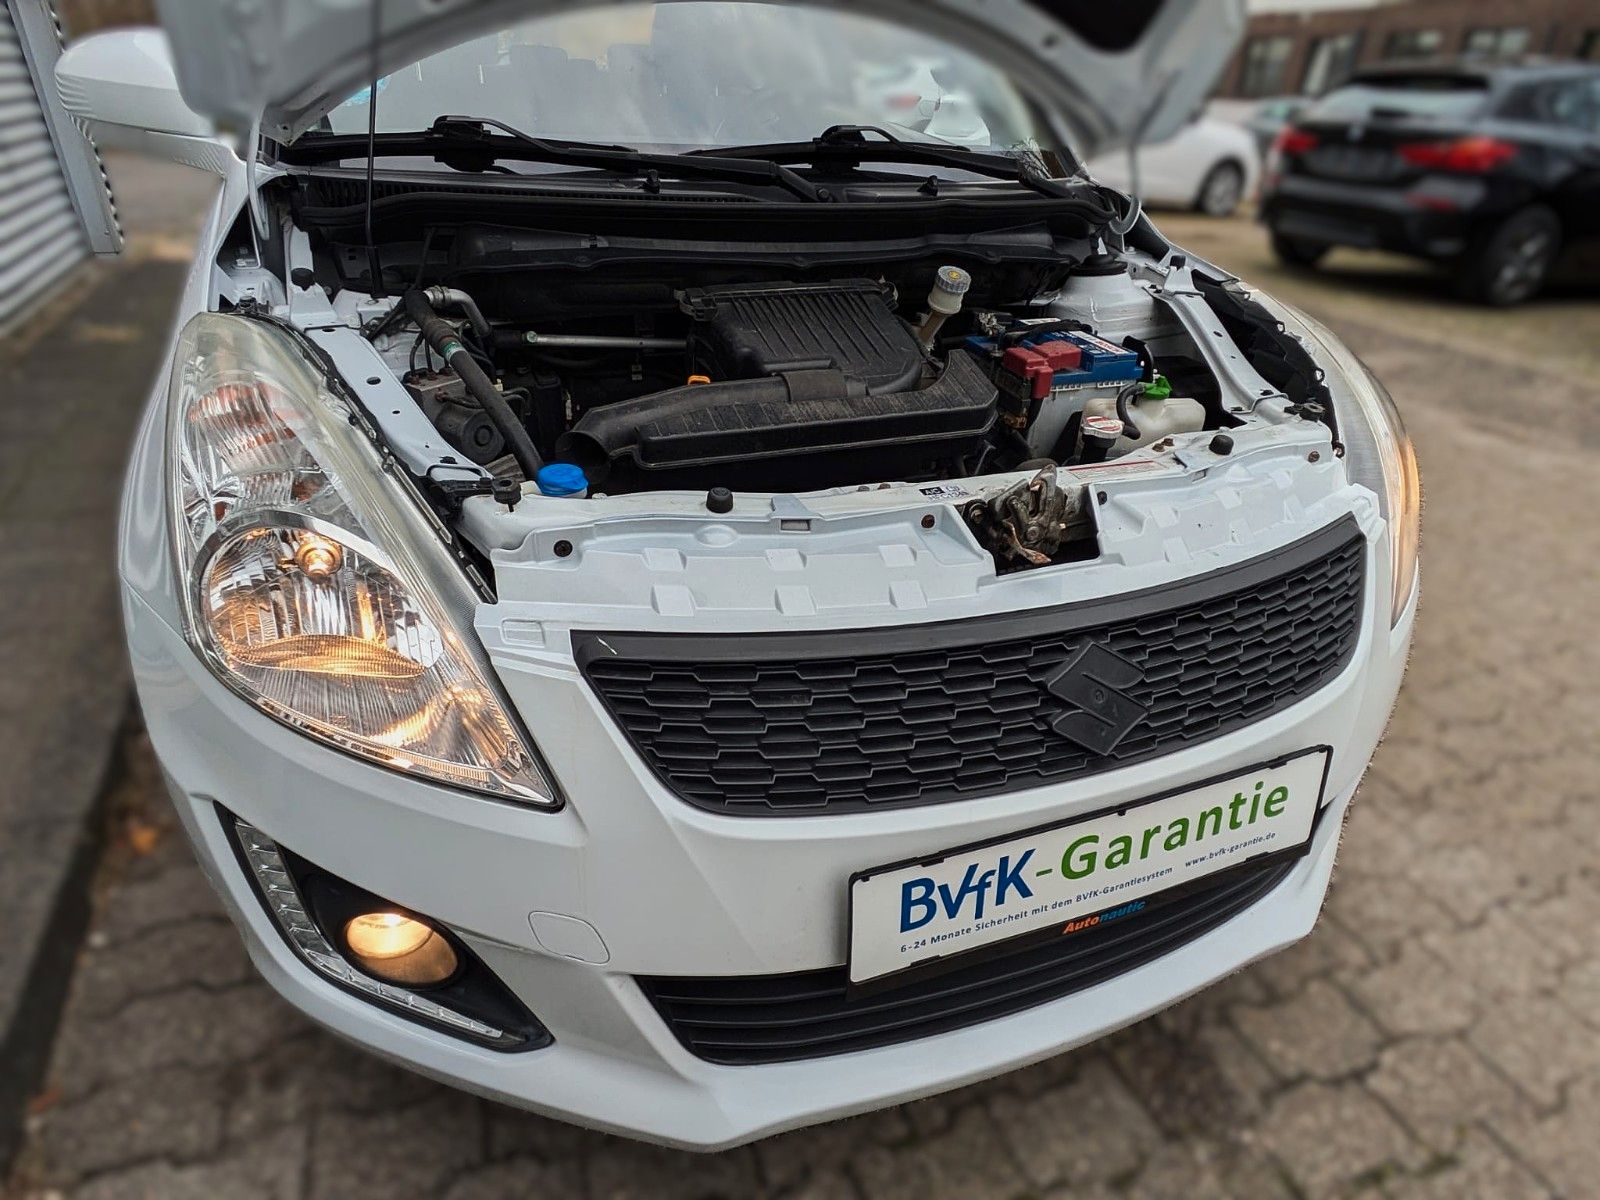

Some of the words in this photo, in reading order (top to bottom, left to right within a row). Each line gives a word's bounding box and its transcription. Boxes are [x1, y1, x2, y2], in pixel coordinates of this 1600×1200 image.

[1185, 832, 1276, 868] www.bvfk-garantie.de
[900, 939, 927, 953] 6-24
[930, 928, 972, 945] Monate
[975, 911, 1028, 932] Sicherheit
[1031, 904, 1048, 916] mit
[1051, 898, 1073, 910] dem
[1062, 900, 1146, 934] Autonautic
